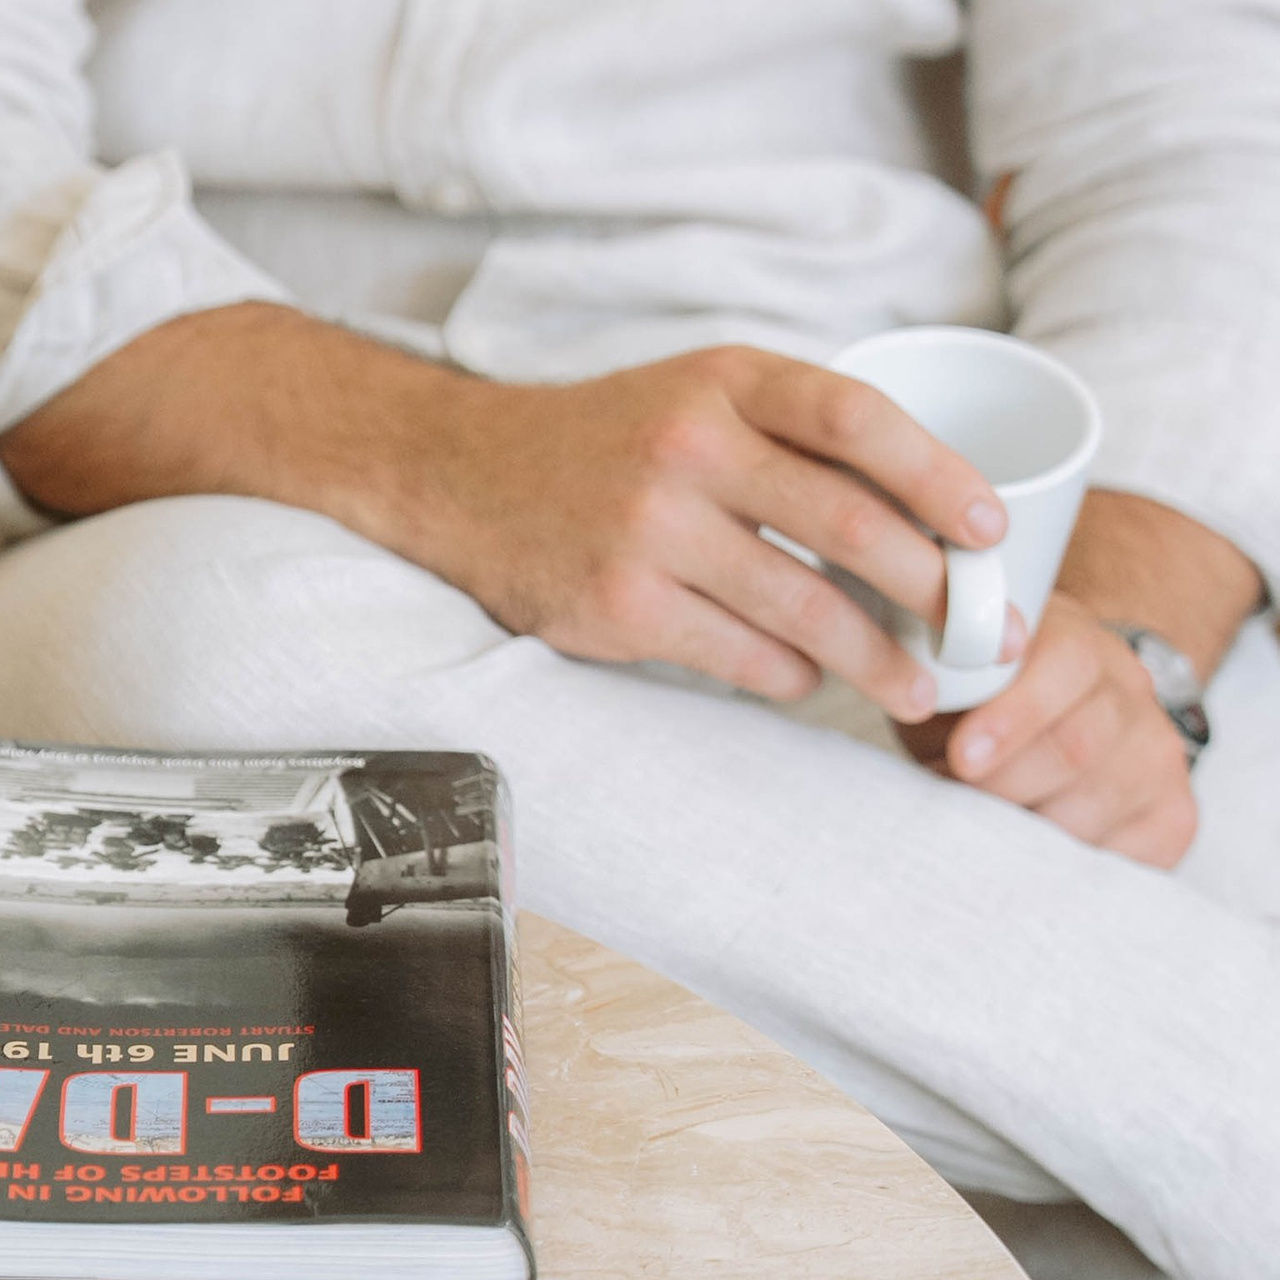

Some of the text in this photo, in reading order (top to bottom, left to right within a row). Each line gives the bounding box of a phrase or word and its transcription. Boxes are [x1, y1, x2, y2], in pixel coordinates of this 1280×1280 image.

[0, 1023, 51, 1034] DALE
[57, 1026, 102, 1036] AND
[109, 1027, 232, 1037] ROBERTSON
[240, 1025, 315, 1036] STUART
[77, 1043, 155, 1064] 6th
[173, 1043, 295, 1063] JUNE
[54, 1164, 107, 1182] OF
[120, 1163, 340, 1182] FOOTSTEPS
[8, 1183, 52, 1202] IN
[66, 1185, 304, 1203] FOLLOWING
